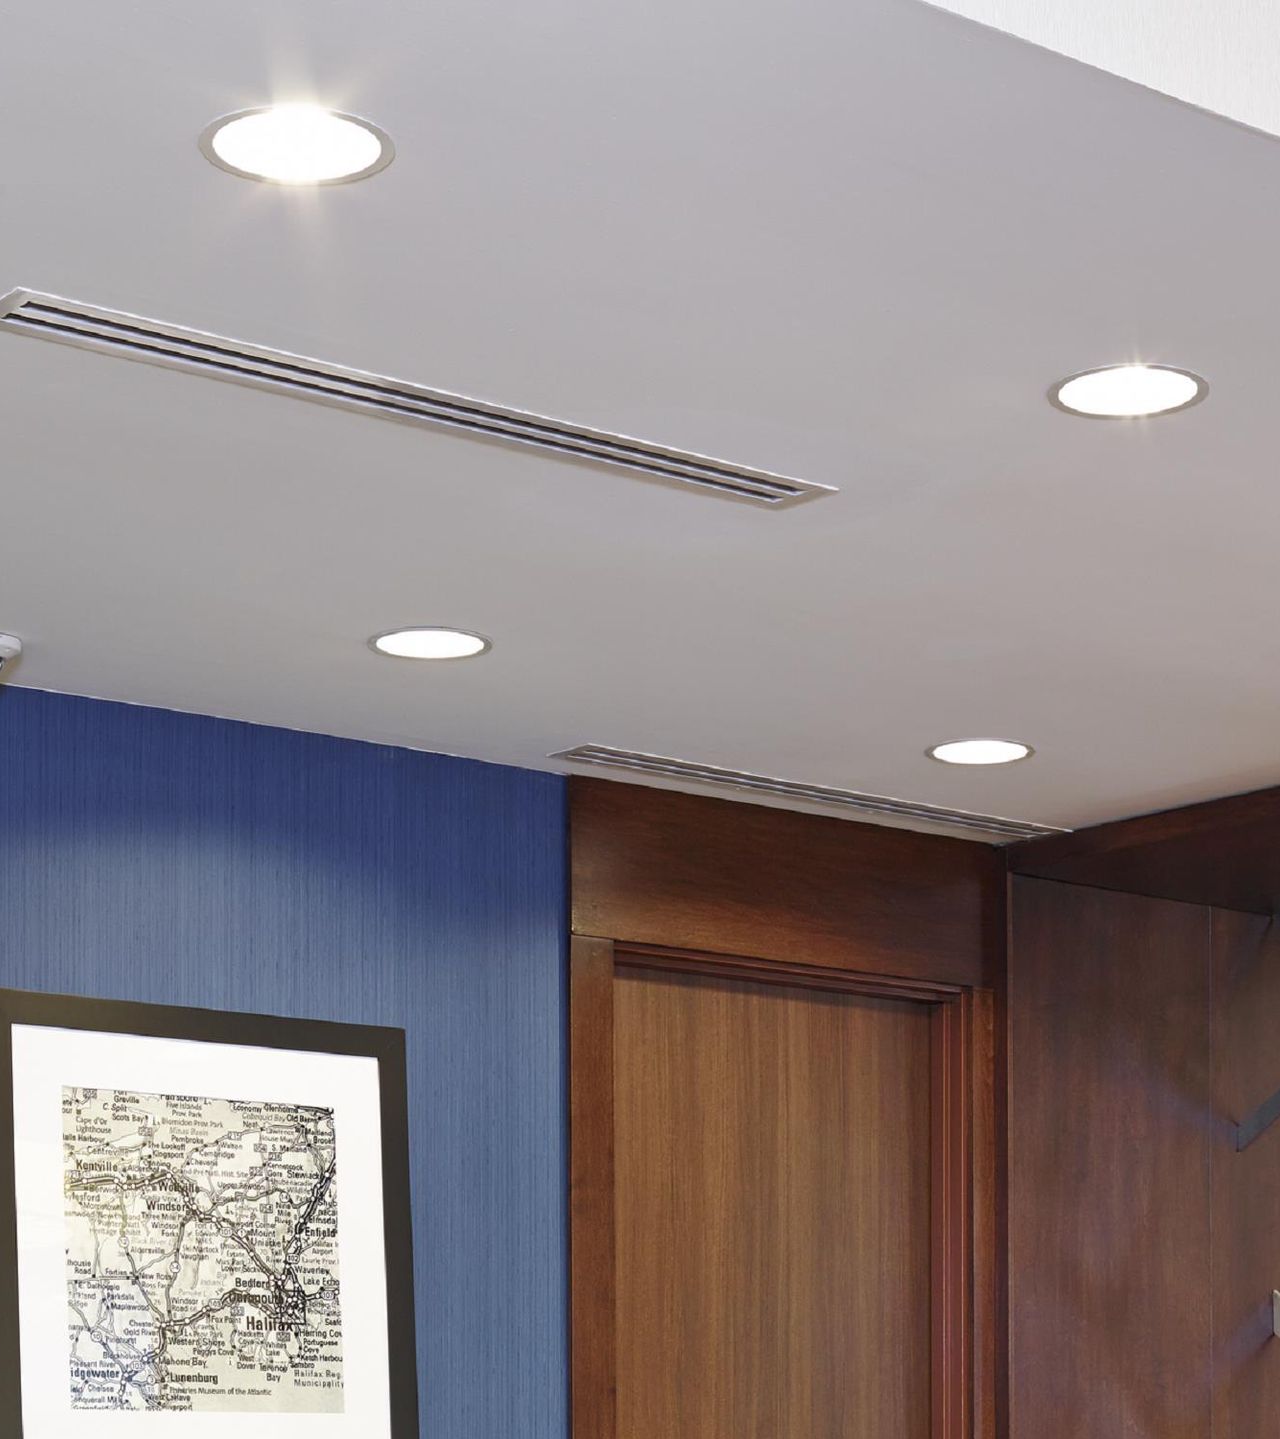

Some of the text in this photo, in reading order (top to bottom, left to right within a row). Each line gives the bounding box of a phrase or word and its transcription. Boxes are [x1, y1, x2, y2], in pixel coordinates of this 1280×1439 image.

[76, 1160, 117, 1171] Kentville
[146, 1201, 185, 1212] Windsor
[303, 1276, 320, 1285] Lake
[247, 1316, 291, 1331] Halifax
[171, 1373, 218, 1385] Lunenburg
[266, 1373, 280, 1383] Bay
[294, 1370, 322, 1378] Halifax
[294, 1379, 344, 1389] Municipality
[198, 1387, 226, 1395] Museum
